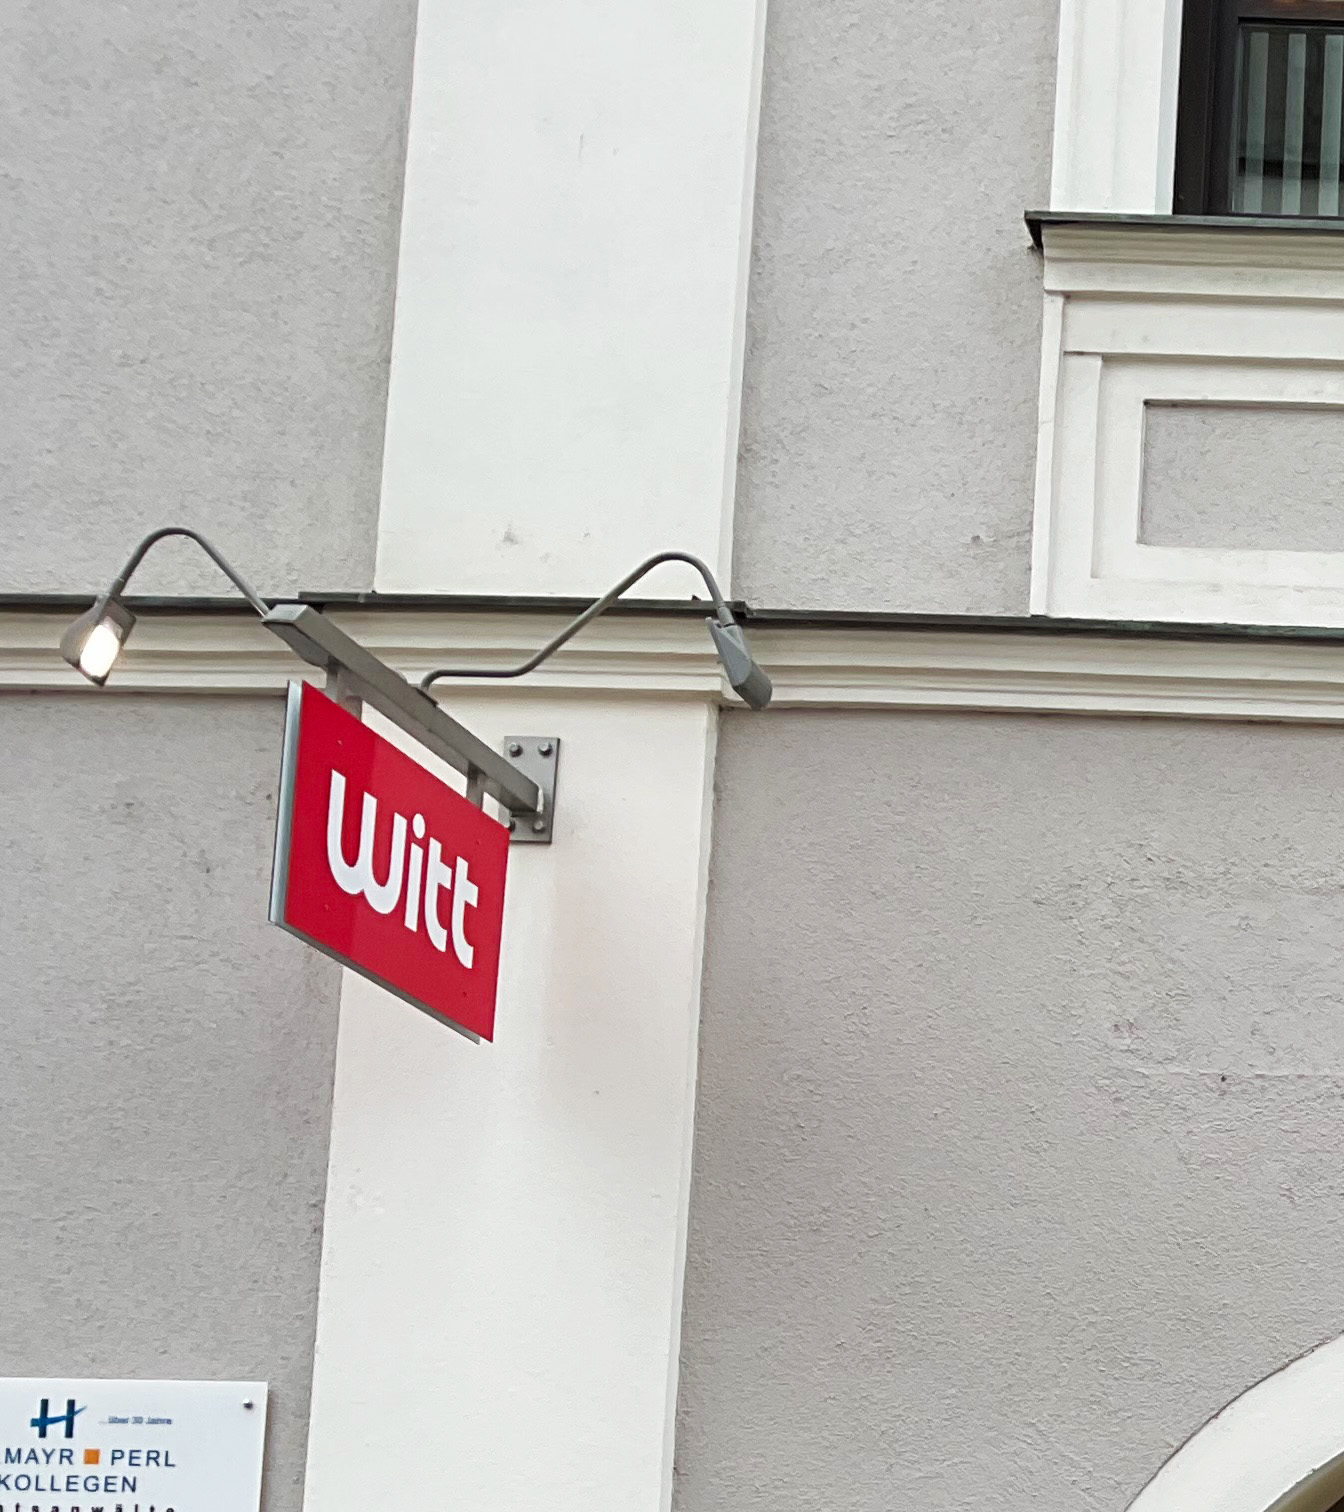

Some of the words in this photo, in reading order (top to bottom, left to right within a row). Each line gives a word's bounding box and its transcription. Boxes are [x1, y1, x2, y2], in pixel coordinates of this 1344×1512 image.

[5, 1447, 73, 1465] MAYR
[111, 1449, 176, 1467] PERL
[0, 1474, 137, 1492] KOLLEGEN
